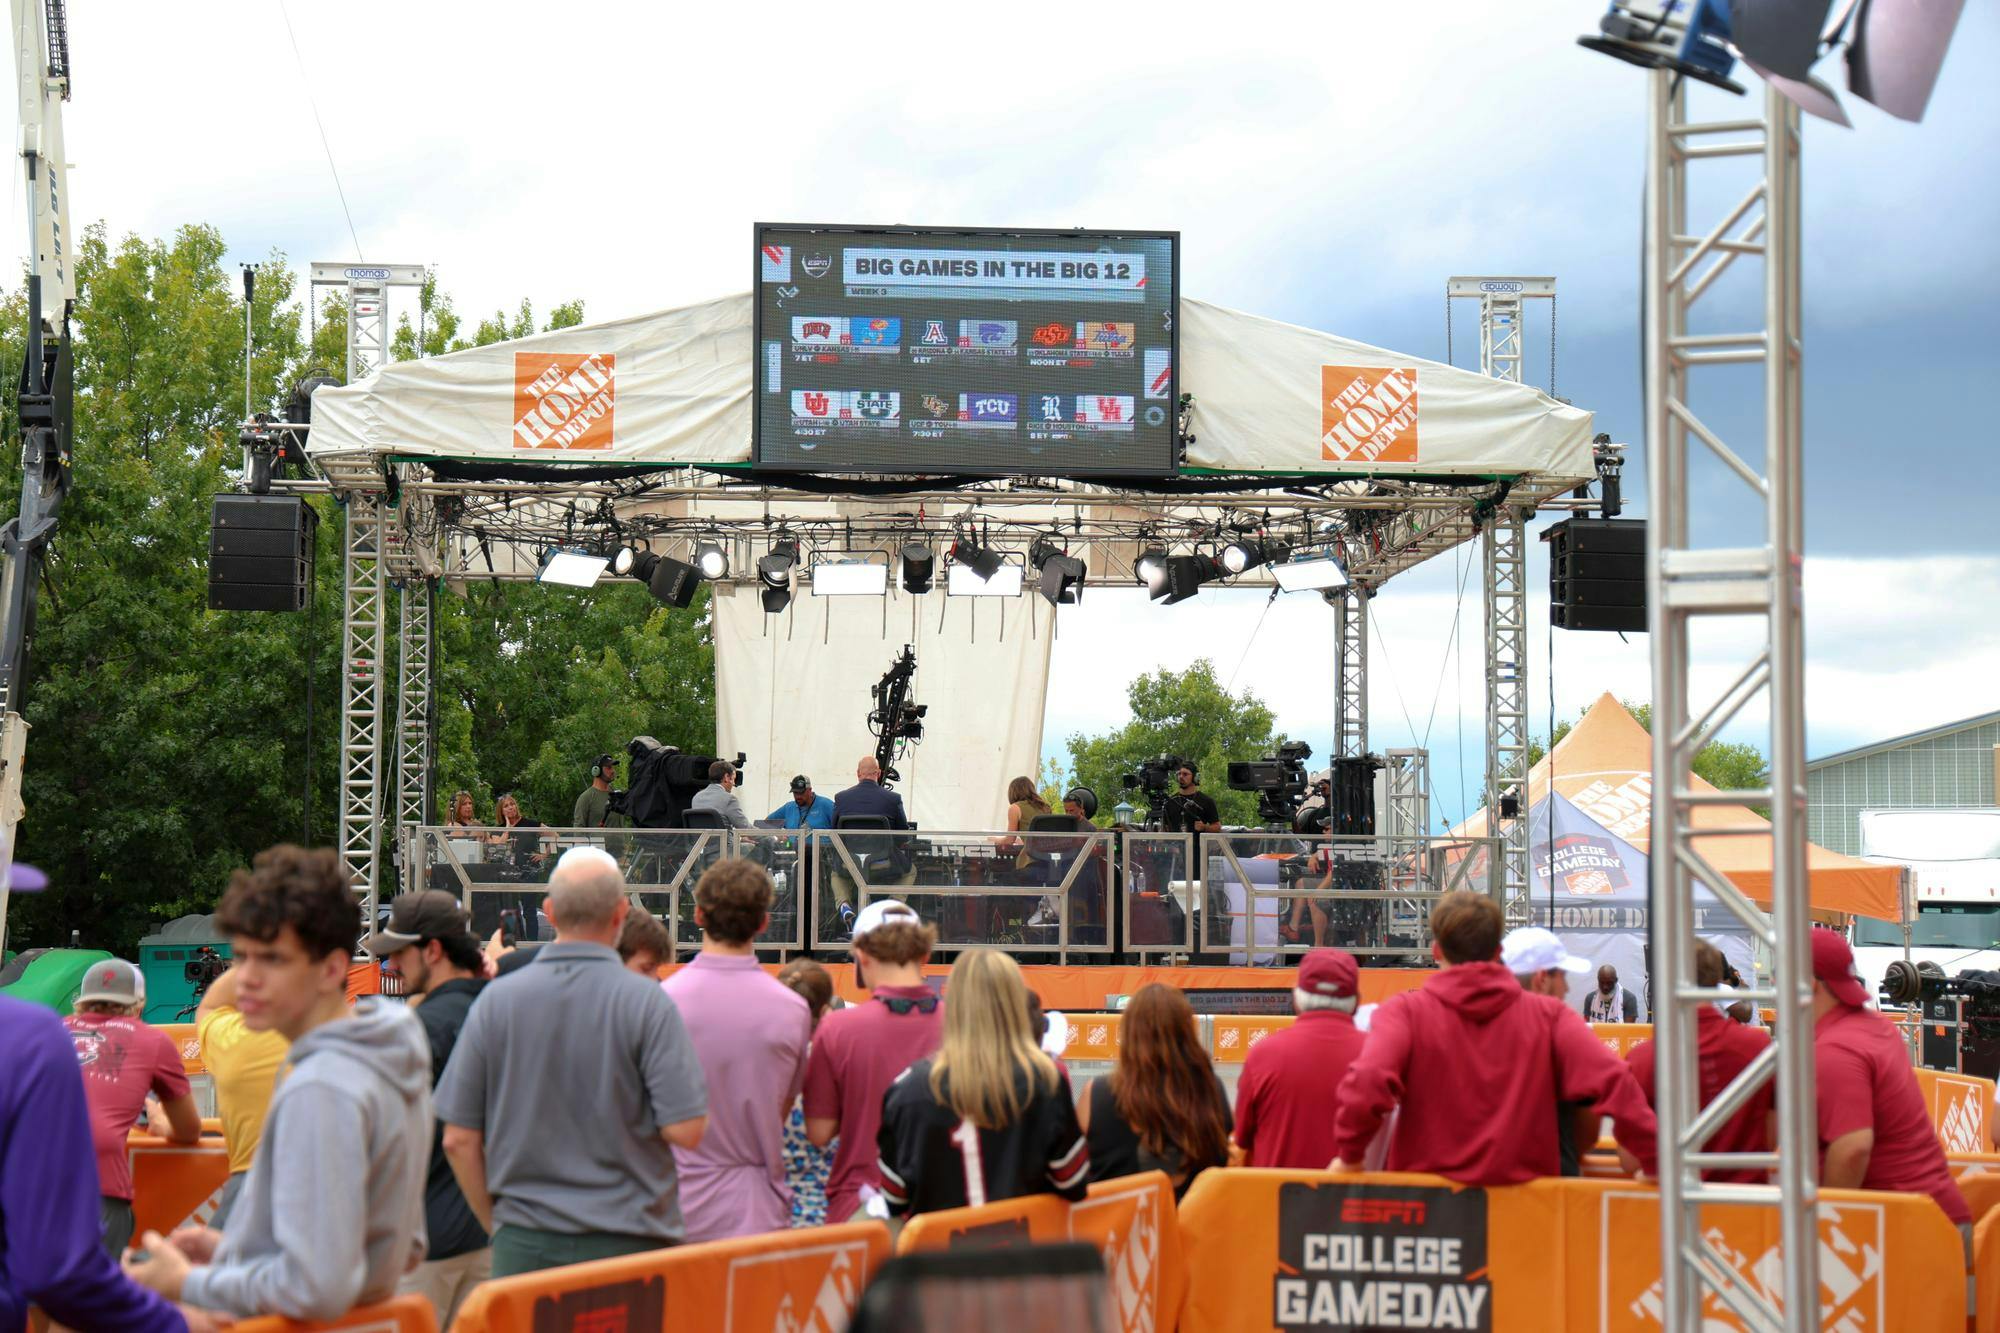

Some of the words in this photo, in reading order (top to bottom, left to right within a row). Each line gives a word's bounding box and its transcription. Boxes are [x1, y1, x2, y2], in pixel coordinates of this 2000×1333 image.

[350, 268, 385, 277] Thomas
[855, 258, 894, 275] BIG
[899, 258, 978, 276] GAMES
[983, 261, 1005, 277] IN
[1011, 261, 1056, 278] THE
[1060, 262, 1098, 279] BIG
[1104, 263, 1130, 279] 12
[851, 287, 879, 295] WEEK
[1484, 283, 1517, 291] Thomas
[523, 363, 567, 400] THE
[513, 353, 616, 448] HOME
[857, 400, 892, 409] STATE
[1330, 375, 1371, 414] THE
[552, 389, 615, 449] DEPOT
[975, 399, 1010, 416] TCU
[1322, 368, 1418, 461] HOME
[1359, 402, 1418, 461] DEPOT
[1537, 855, 1620, 878] GAMEDAY
[1544, 845, 1608, 864] COLLEGE
[1544, 907, 1618, 928] HOME
[1339, 1197, 1426, 1225] ESPN
[1303, 1233, 1463, 1276] COLLEGE
[1276, 1278, 1487, 1330] GAMEDAY
